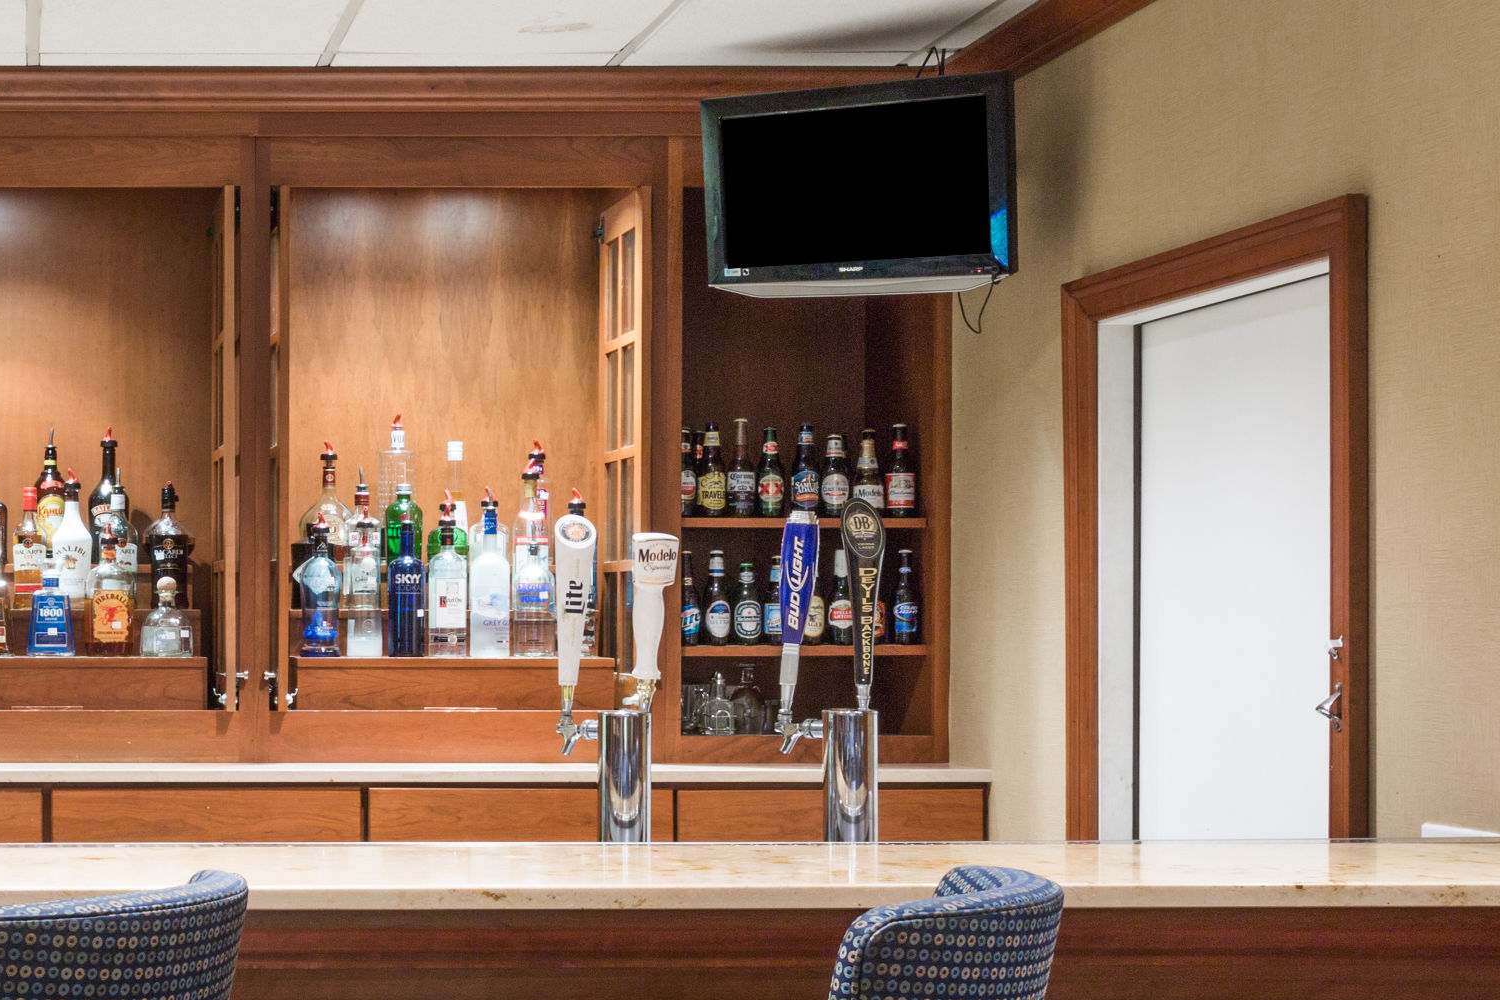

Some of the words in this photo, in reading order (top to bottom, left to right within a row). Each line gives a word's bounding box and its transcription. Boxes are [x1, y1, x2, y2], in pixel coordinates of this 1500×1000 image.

[638, 548, 678, 563] Modelo
[790, 536, 805, 586] LIGHT
[395, 574, 422, 584] SKYY
[40, 608, 63, 617] 1800
[565, 580, 585, 615] Lite
[787, 591, 801, 631] BUD
[860, 616, 874, 675] BACKBONE
